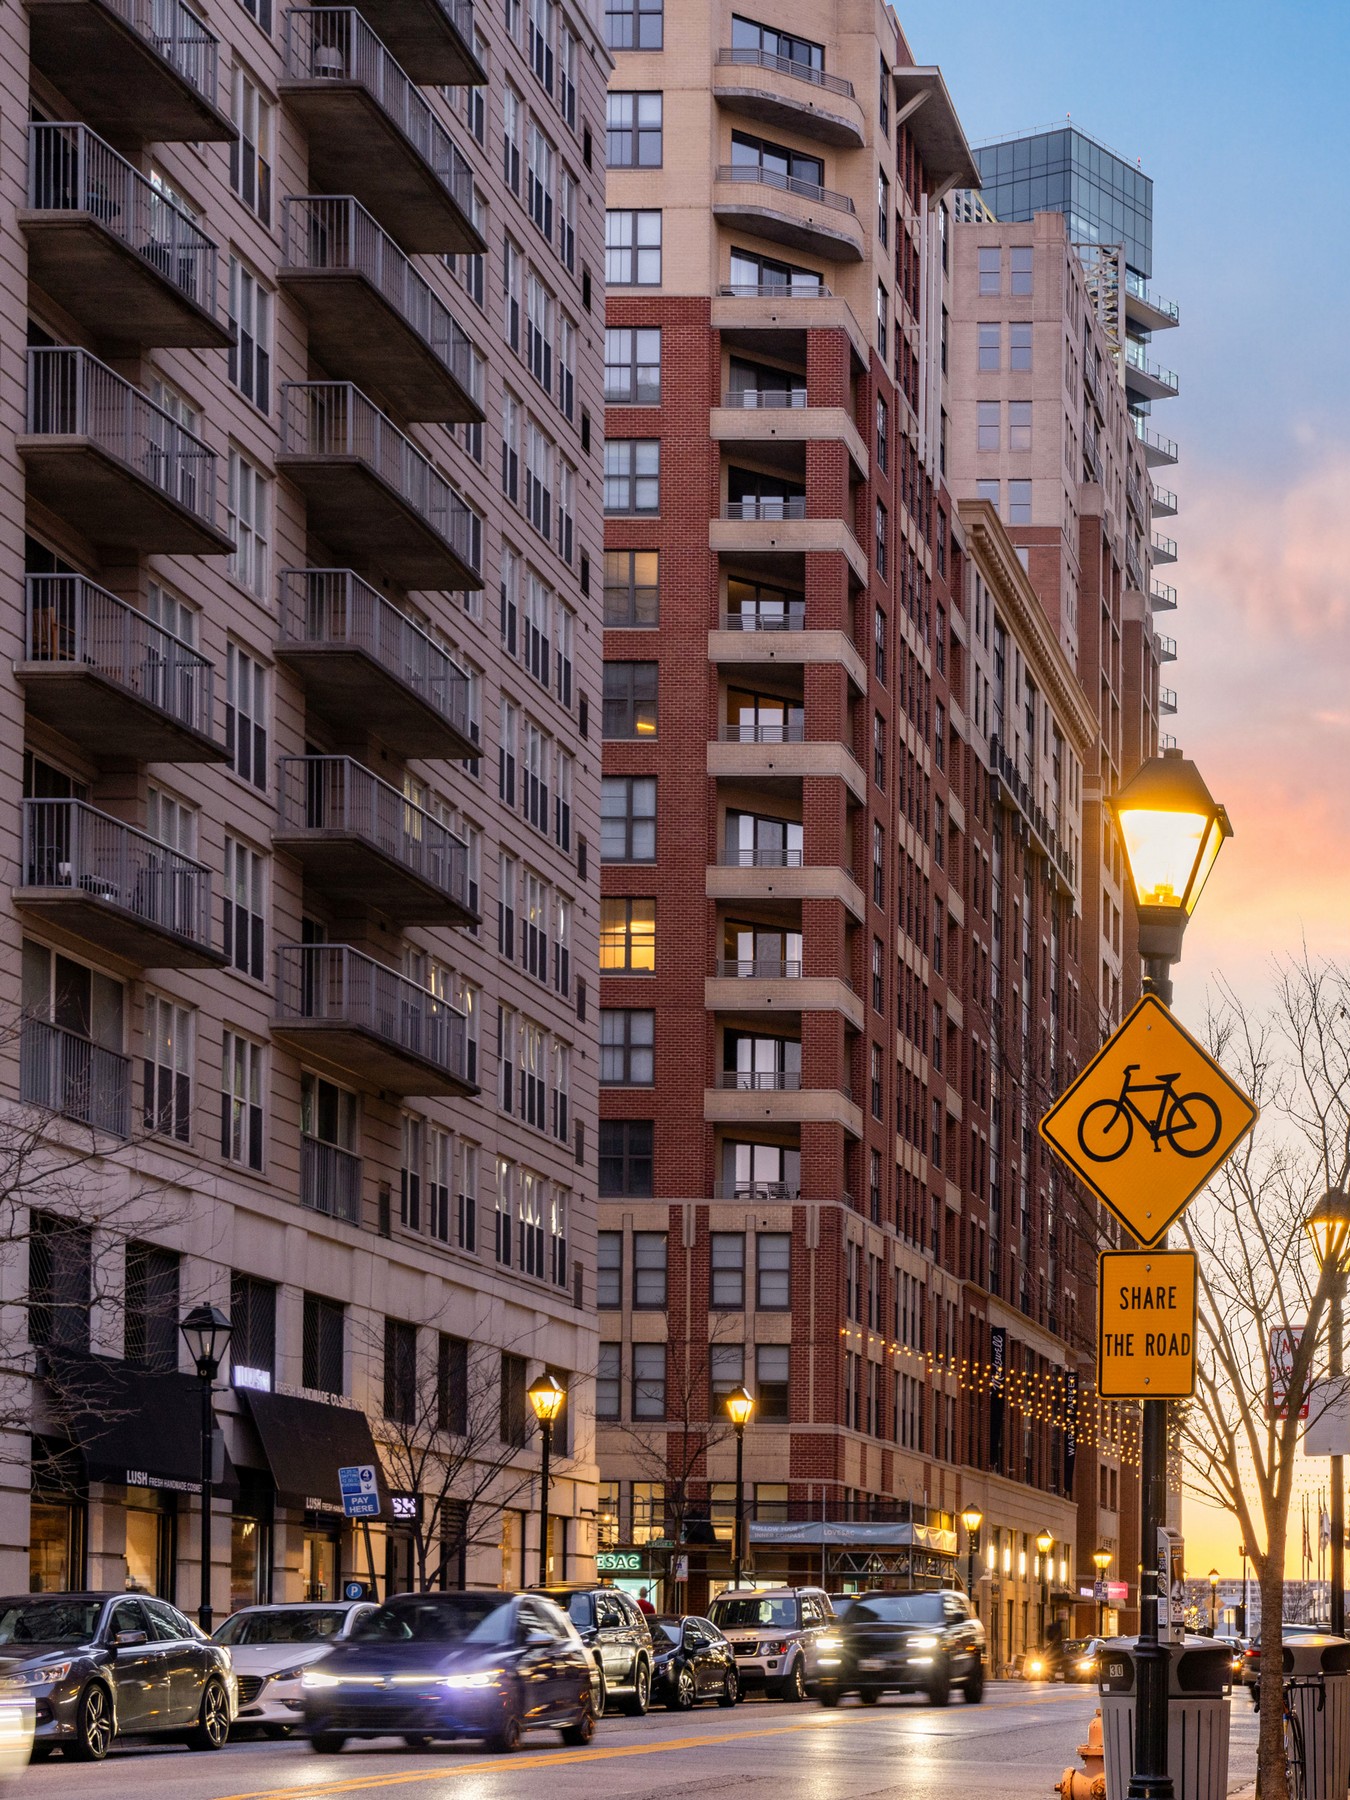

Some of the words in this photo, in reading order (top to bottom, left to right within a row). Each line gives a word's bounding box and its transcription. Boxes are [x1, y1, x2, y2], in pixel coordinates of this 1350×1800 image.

[1120, 1286, 1177, 1310] SHARE
[1104, 1333, 1134, 1357] THE
[1145, 1332, 1191, 1357] ROAD
[362, 1470, 370, 1478] 4
[126, 1470, 148, 1486] LUSH
[148, 1477, 164, 1487] FRESH
[164, 1479, 187, 1491] HANDMADE
[306, 1497, 322, 1510] LUSH
[351, 1497, 369, 1505] PAY
[349, 1505, 374, 1513] HERE
[823, 1529, 855, 1537] LOVESAC
[350, 1585, 359, 1597] P
[1110, 1664, 1123, 1676] 30
